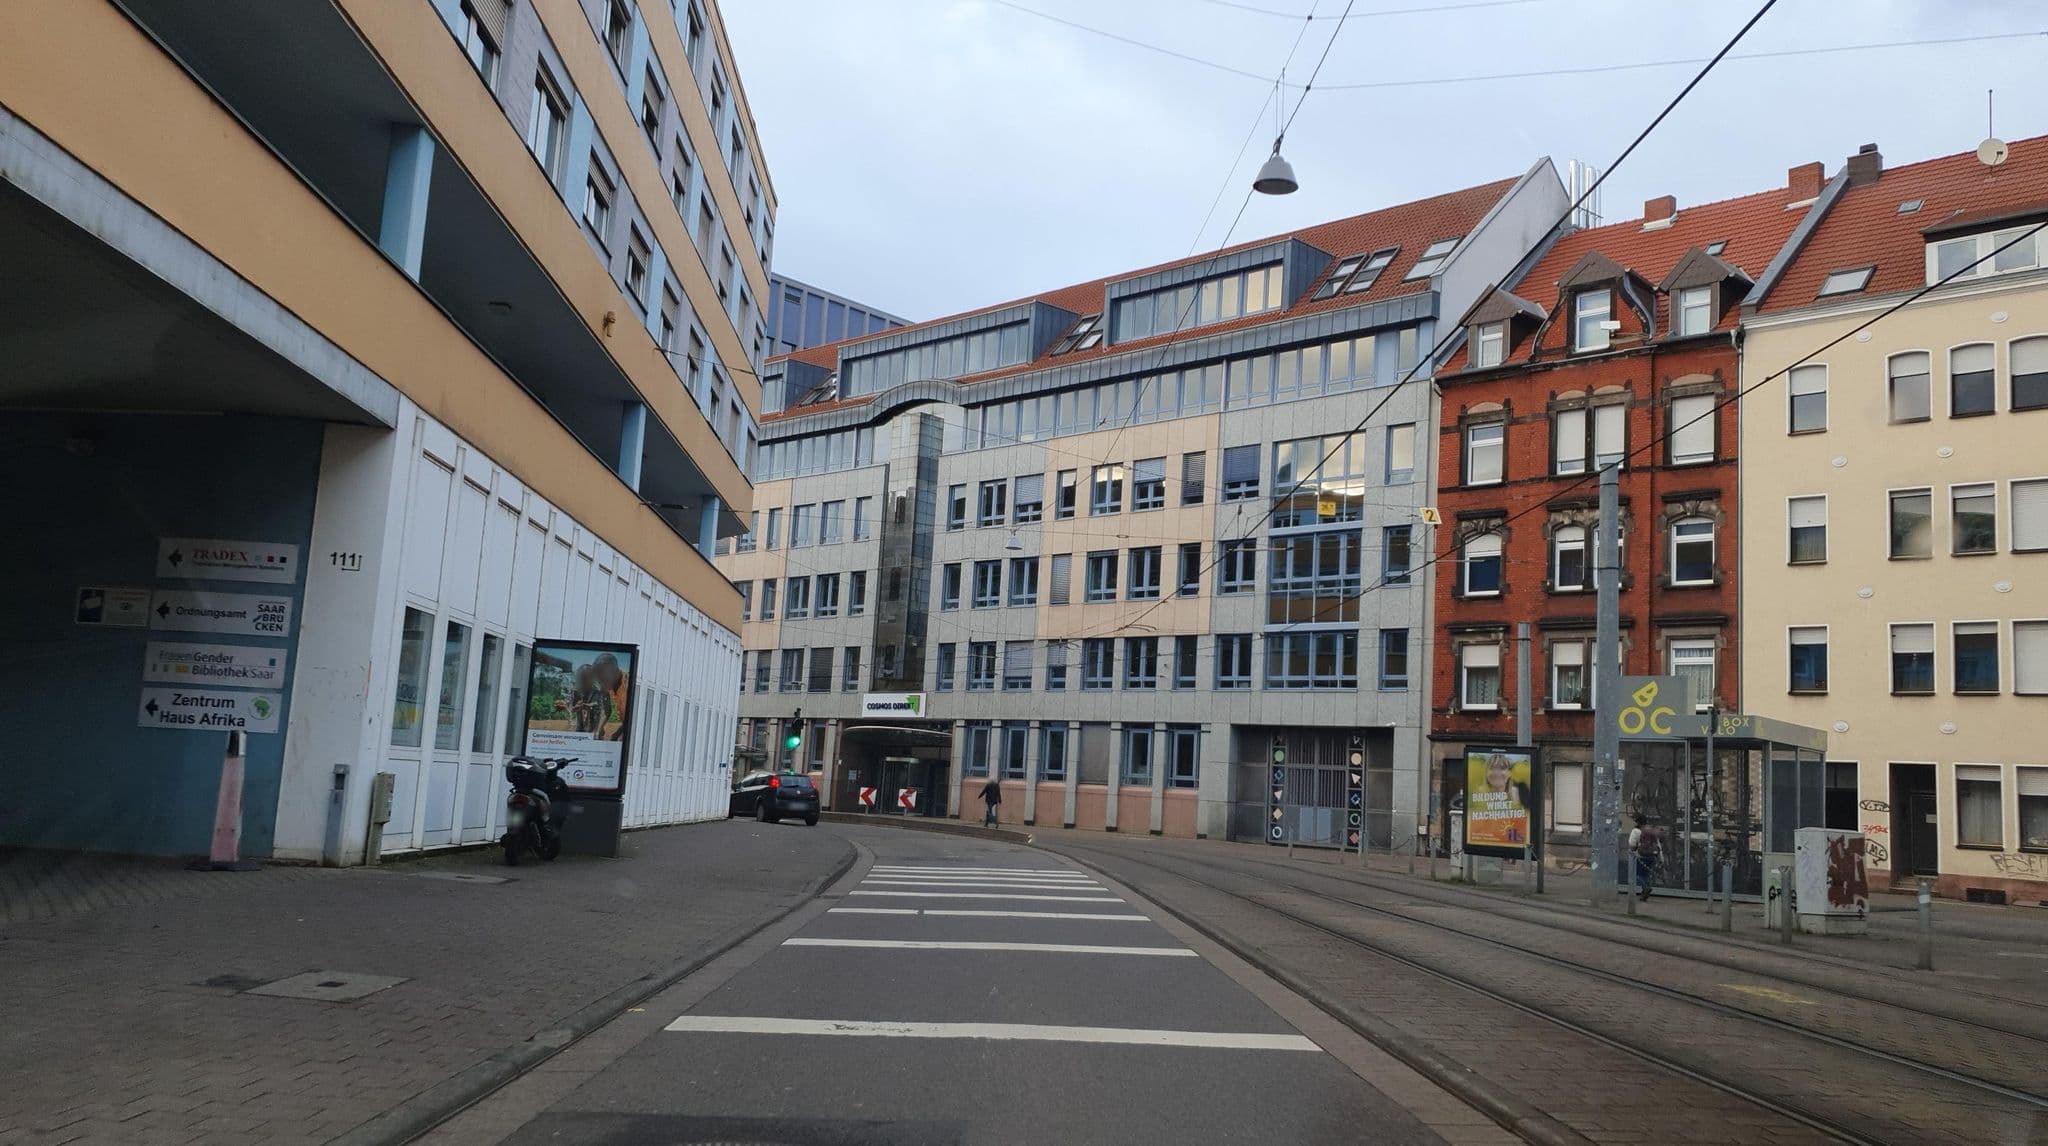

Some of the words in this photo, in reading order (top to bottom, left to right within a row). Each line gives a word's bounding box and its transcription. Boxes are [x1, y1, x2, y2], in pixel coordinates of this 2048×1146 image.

[1425, 509, 1436, 522] 2
[192, 549, 249, 561] TRADEX
[175, 605, 247, 620] Ordnungsamt
[257, 604, 285, 614] SAAR
[255, 622, 283, 632] CKEN
[171, 693, 236, 709] Zentrum
[159, 710, 195, 724] Haus
[199, 713, 246, 727] Afrika
[1723, 717, 1749, 727] BOX
[1701, 725, 1736, 735] VLO
[1472, 792, 1508, 802] BILDUNG
[1487, 800, 1513, 810] WIRKT
[1472, 809, 1525, 820] NACHHALTIG!
